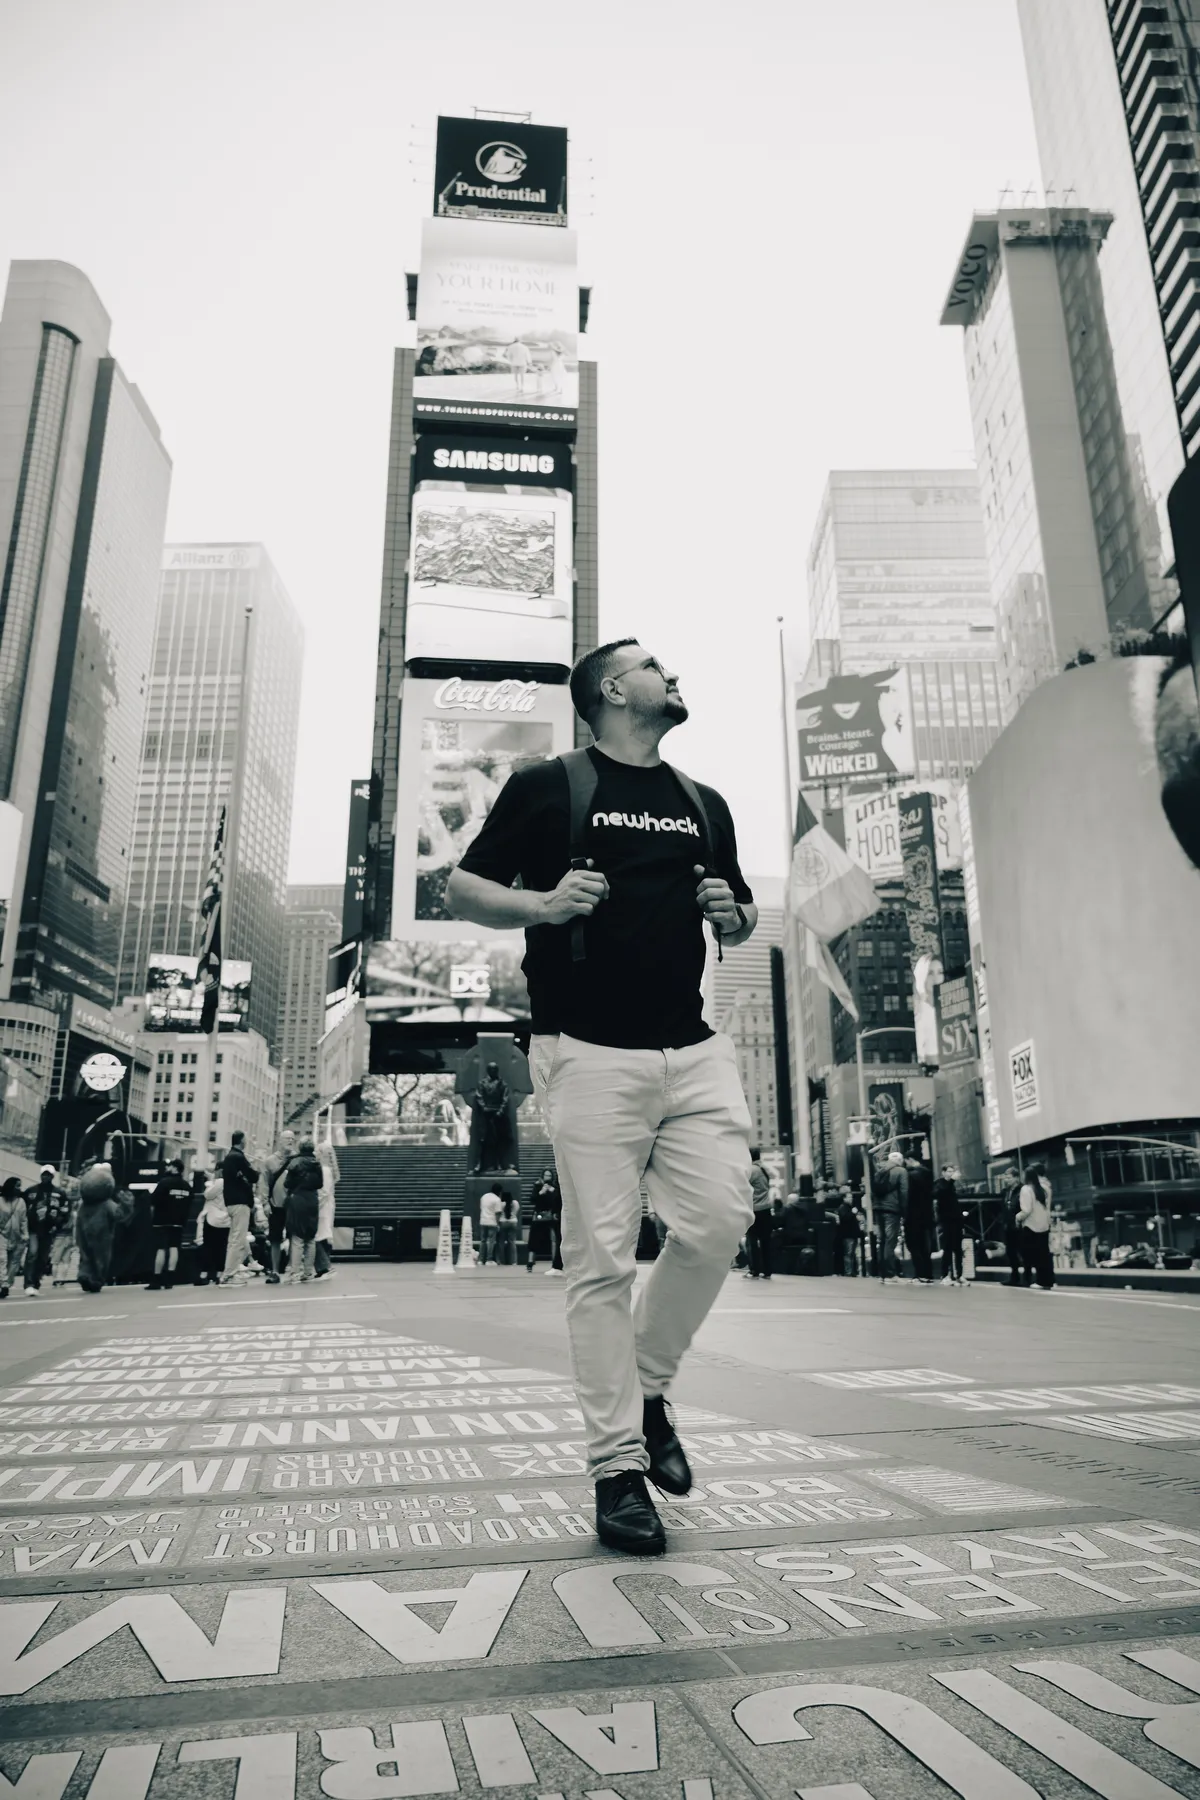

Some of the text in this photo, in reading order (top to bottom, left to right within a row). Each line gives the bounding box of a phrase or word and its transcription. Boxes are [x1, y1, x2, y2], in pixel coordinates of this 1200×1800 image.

[455, 181, 546, 203] Prudential
[434, 448, 554, 474] SAMSUNG
[171, 550, 225, 565] Allianz
[434, 676, 542, 713] Coca-Cola
[818, 740, 863, 752] Courage.
[593, 811, 700, 837] newhack
[1012, 1051, 1034, 1085] FOX
[27, 1356, 481, 1384] AMBASSADOR
[53, 1350, 301, 1370] GERSHWIN
[1, 1380, 220, 1402] O'NEILL
[302, 1370, 493, 1391] KERR
[224, 1395, 527, 1417] BARRYMORE
[228, 1385, 573, 1407] ONGACRE
[276, 1447, 474, 1470] RODGERS
[685, 1443, 861, 1466] MUSI
[273, 1462, 485, 1489] RICHARD
[215, 1507, 479, 1529] GERALD
[219, 1496, 472, 1519] SCHOENFELD
[655, 1497, 893, 1530] SHUBER
[202, 1513, 597, 1559] BROADHURST
[656, 1588, 791, 1641] ST
[896, 1623, 1127, 1652] STREET
